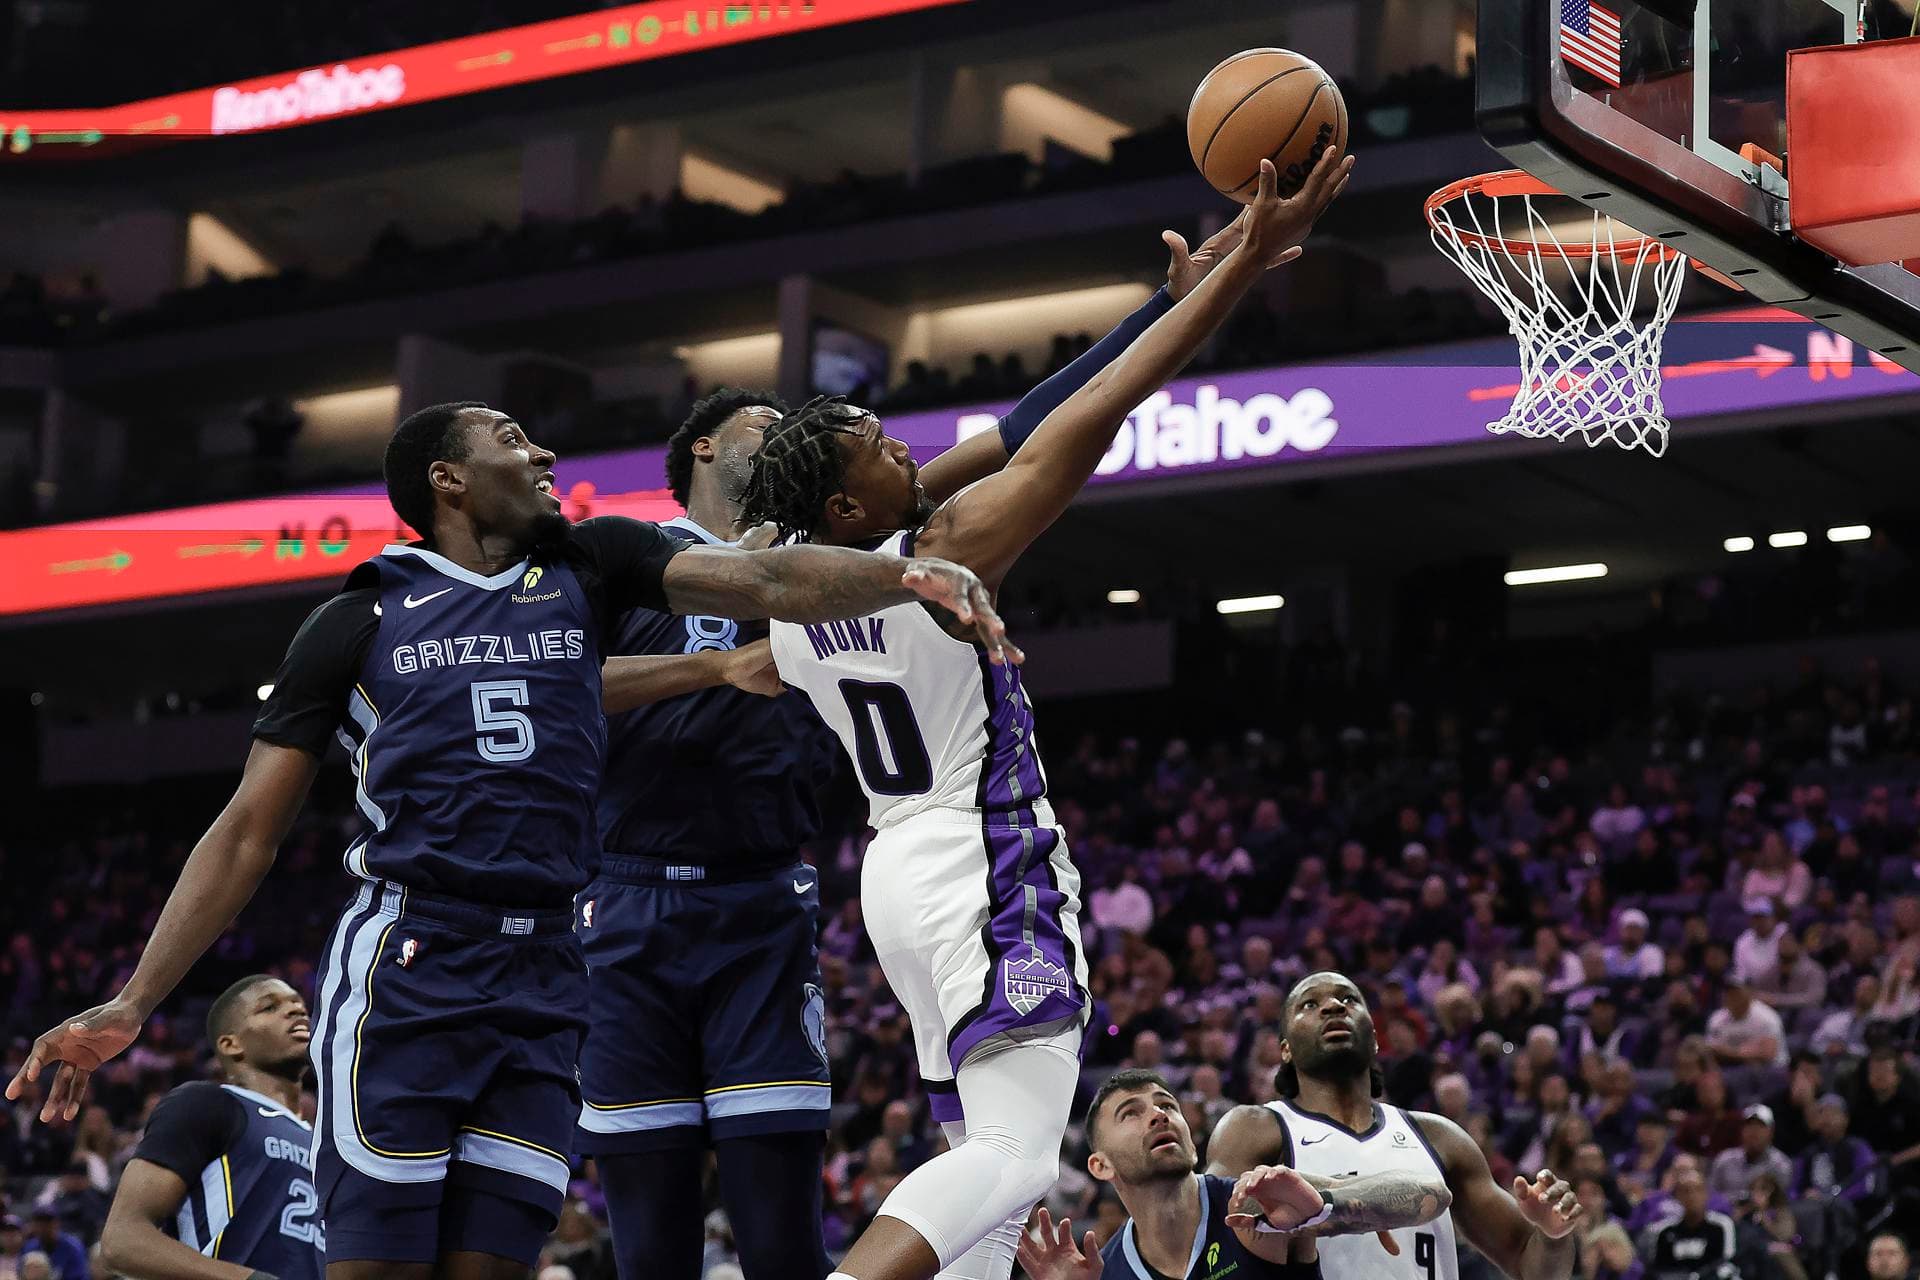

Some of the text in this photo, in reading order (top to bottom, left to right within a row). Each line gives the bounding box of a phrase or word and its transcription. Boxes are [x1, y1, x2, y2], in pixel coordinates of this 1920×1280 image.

[511, 588, 562, 604] Robinhood
[392, 629, 584, 674] GRIZZLIES
[804, 617, 888, 662] MUNK
[471, 679, 536, 762] 5
[837, 678, 934, 796] 0
[1009, 973, 1066, 986] SACRAMENTO
